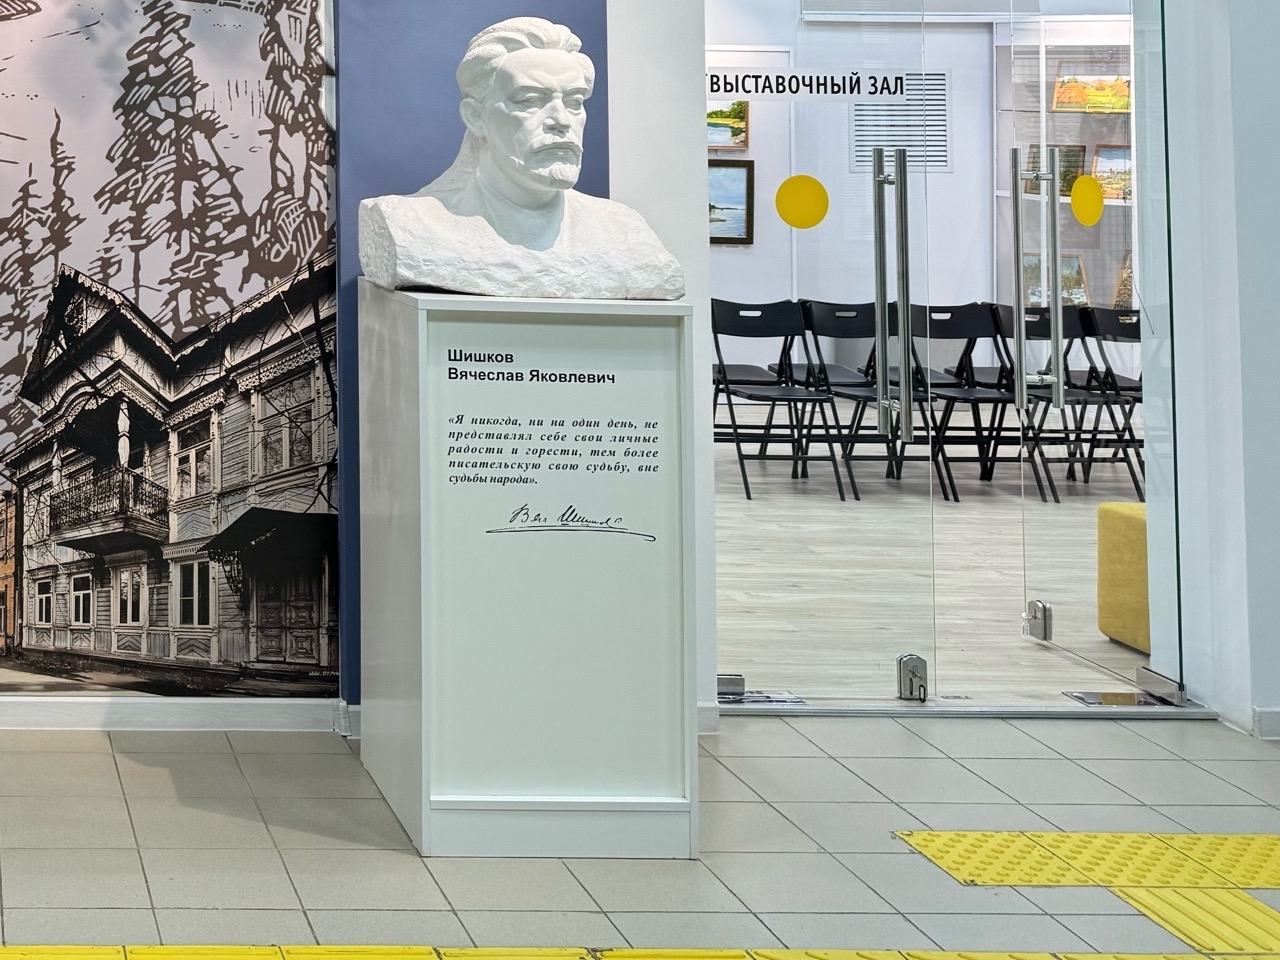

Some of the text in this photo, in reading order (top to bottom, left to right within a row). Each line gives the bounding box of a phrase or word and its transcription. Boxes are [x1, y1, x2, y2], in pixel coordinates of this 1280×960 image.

[710, 71, 904, 96] ВЫСТАВОЧНЫЙ ЗАЛ
[448, 348, 514, 364] Шишков
[448, 367, 616, 384] Вячеслав Яковлевич
[448, 415, 464, 424] «Я
[471, 417, 521, 427] никогда,
[551, 419, 565, 427] на
[572, 418, 600, 427] один
[607, 419, 637, 429] день,
[645, 420, 658, 429] не
[448, 430, 658, 443] представлял себе свои личные
[448, 445, 504, 456] радости
[526, 448, 582, 457] горести,
[590, 449, 616, 457] тем
[624, 447, 658, 458] более
[449, 460, 659, 474] писательскую свою судьбу, вне
[449, 474, 538, 486] судьбы народа».
